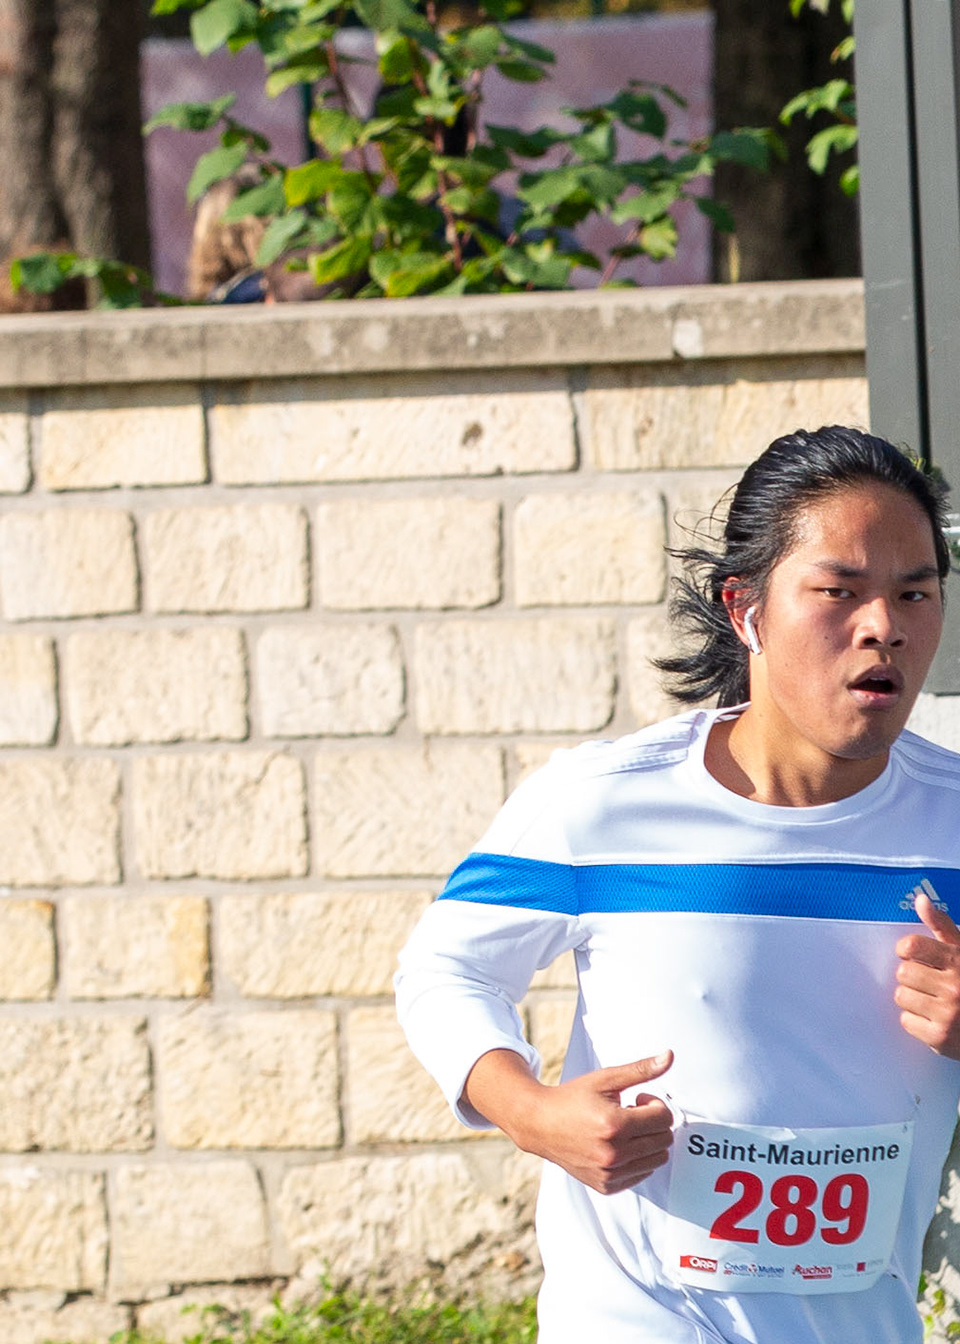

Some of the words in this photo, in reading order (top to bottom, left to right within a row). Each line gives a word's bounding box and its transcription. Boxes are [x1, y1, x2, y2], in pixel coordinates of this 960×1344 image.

[899, 901, 949, 913] adas
[687, 1134, 900, 1166] Saint-Maurienne
[709, 1170, 869, 1247] 289
[689, 1257, 716, 1272] ORPI
[792, 1264, 833, 1275] Auchan
